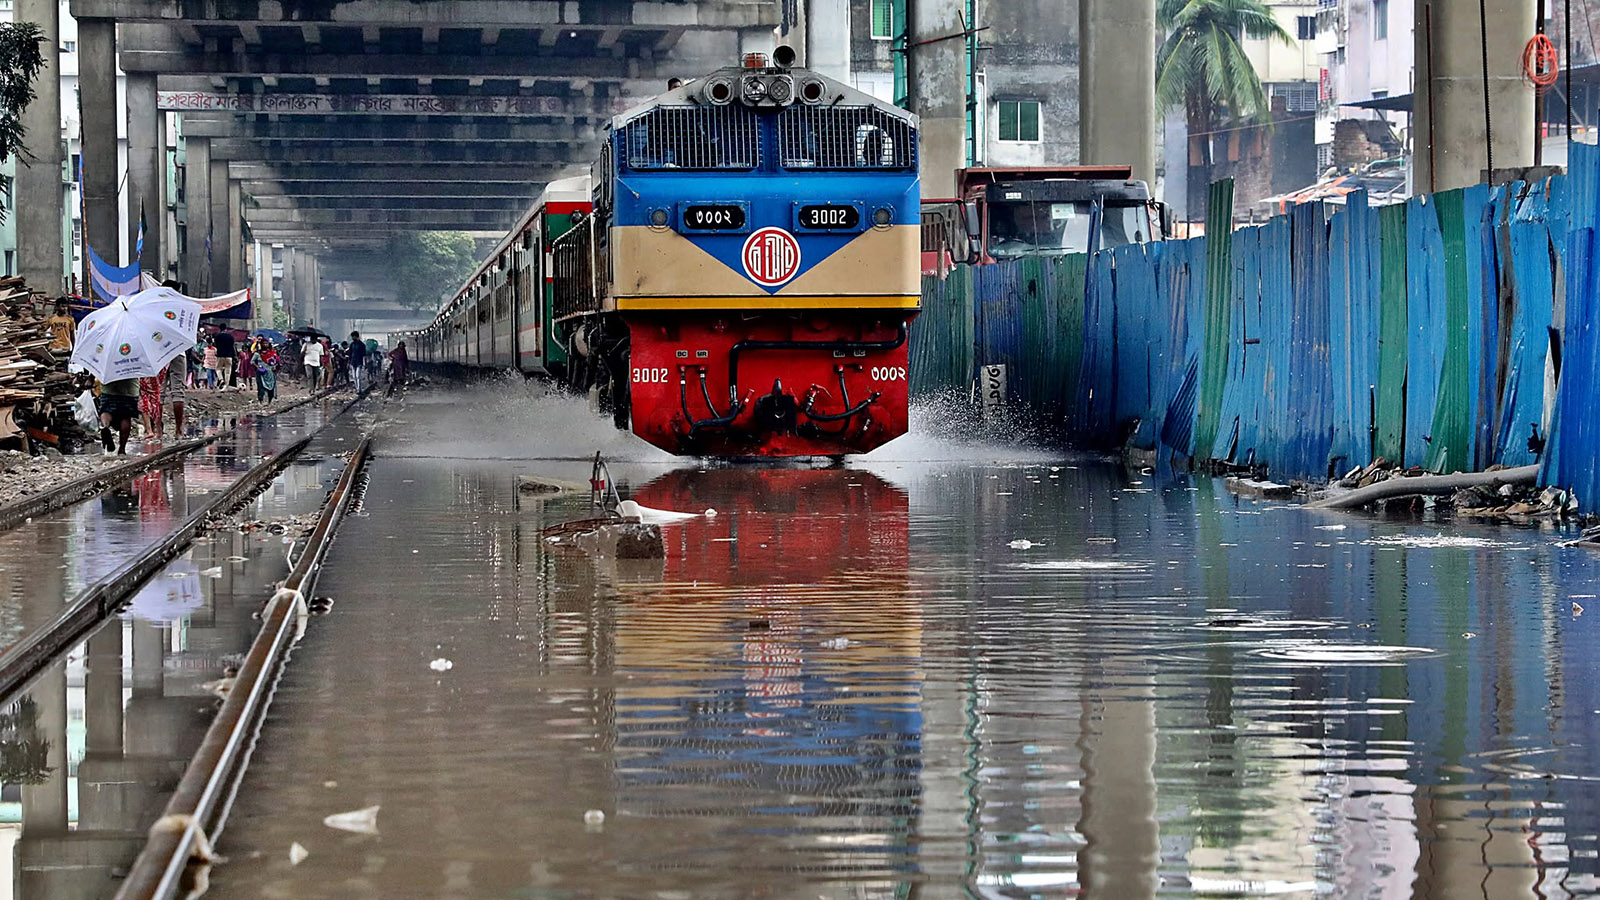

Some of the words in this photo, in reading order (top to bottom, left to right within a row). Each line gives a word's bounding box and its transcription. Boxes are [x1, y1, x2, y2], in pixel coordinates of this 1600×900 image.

[696, 210, 733, 225] ৩০০২
[811, 209, 847, 225] 3002
[632, 367, 669, 383] 3002
[871, 366, 907, 382] ৩০০২
